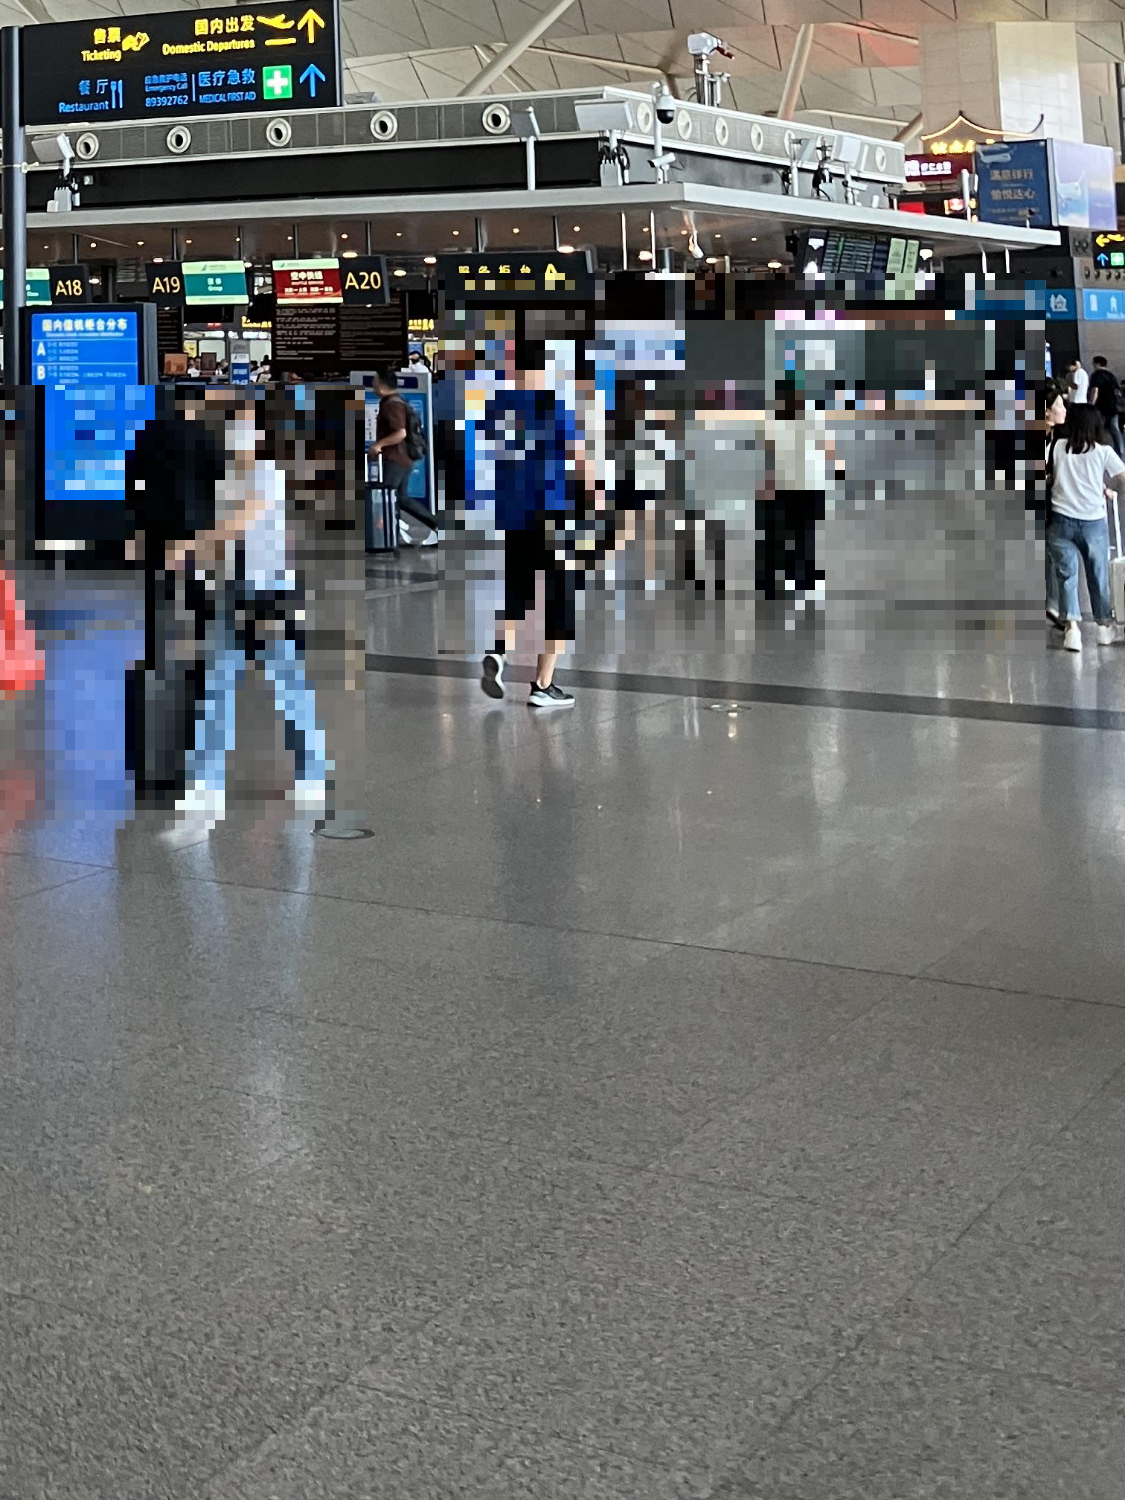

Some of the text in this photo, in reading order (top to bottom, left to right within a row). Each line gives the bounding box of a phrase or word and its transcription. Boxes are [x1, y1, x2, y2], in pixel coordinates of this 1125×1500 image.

[194, 14, 255, 36] 国内出发
[93, 26, 121, 45] 售票
[81, 49, 122, 62] Ticketing
[162, 38, 255, 56] Domestic Departures
[198, 68, 256, 88] 医疗急救
[78, 78, 109, 96] 餐厅
[58, 101, 109, 113] Restaurant
[145, 95, 189, 108] 89392762
[55, 279, 83, 296] A18
[152, 276, 181, 293] A19
[344, 271, 382, 290] A20
[41, 318, 128, 332] 国内值机柜台分布
[36, 341, 46, 357] A
[36, 365, 46, 380] B
